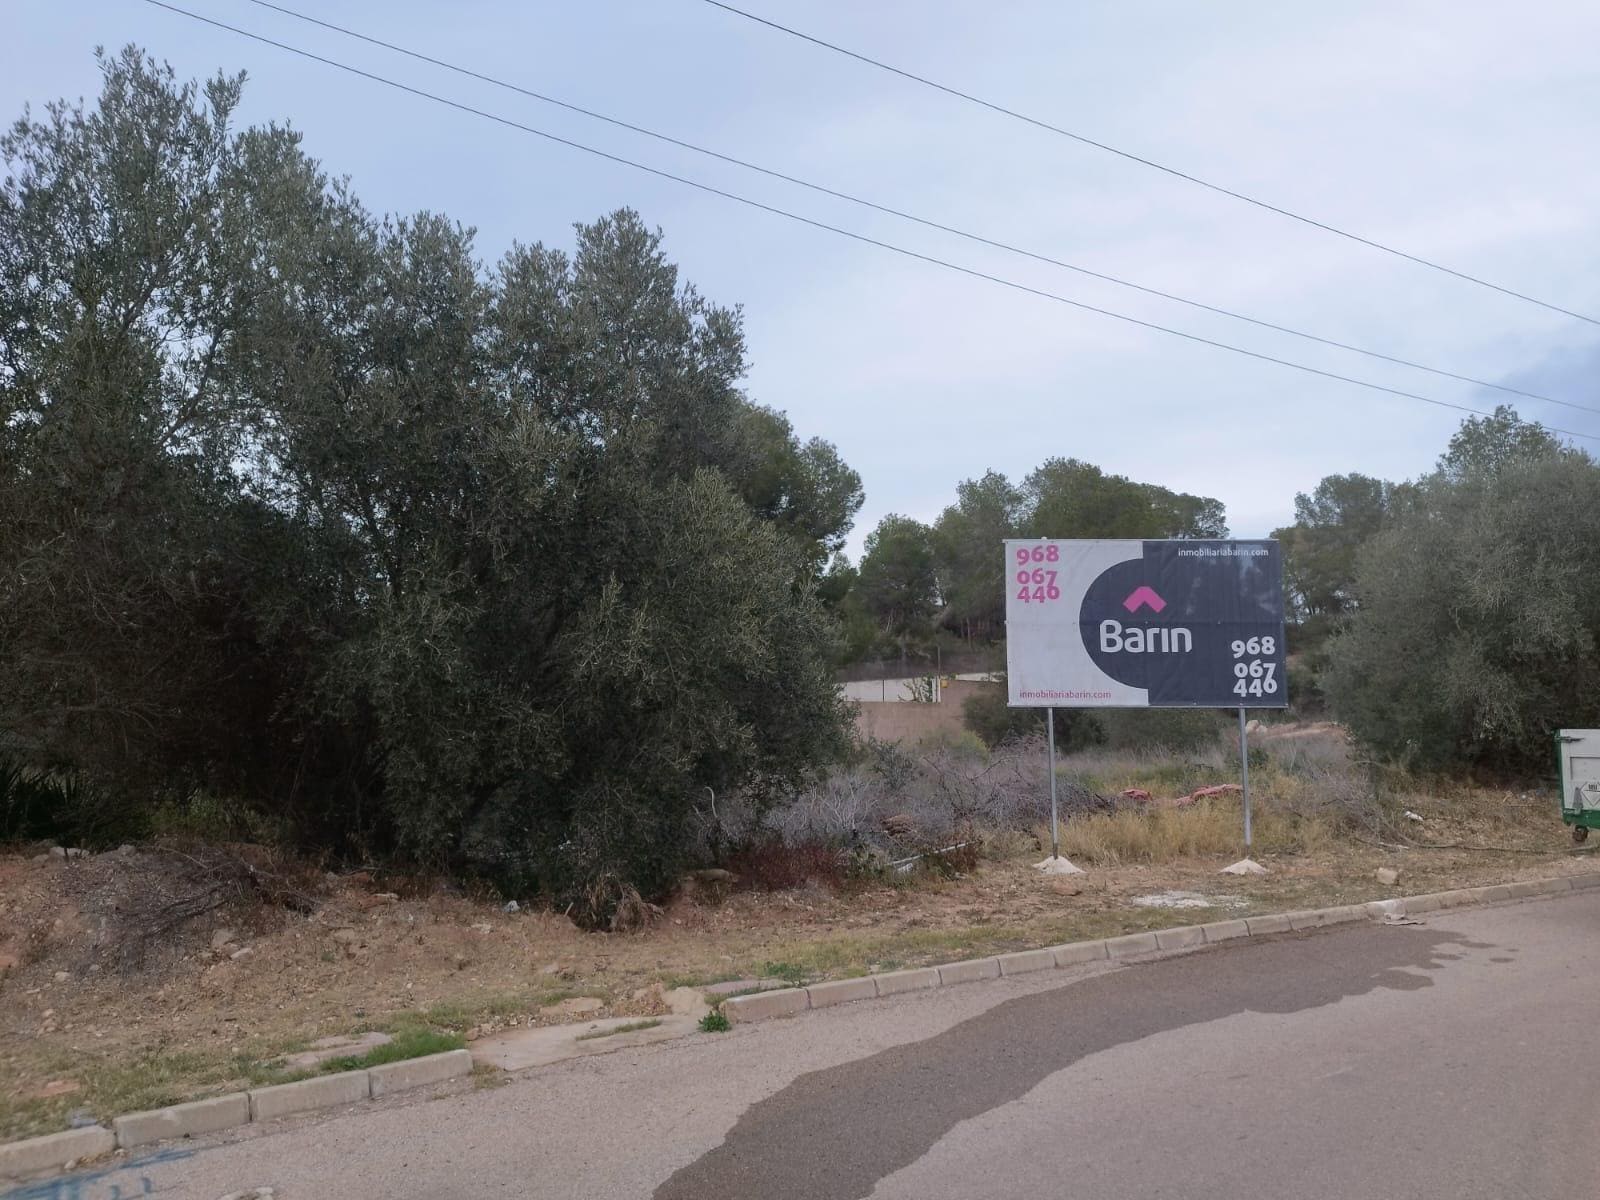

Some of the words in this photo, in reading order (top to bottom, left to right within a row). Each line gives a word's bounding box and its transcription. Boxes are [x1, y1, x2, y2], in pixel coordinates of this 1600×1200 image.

[1016, 544, 1059, 566] 968
[1177, 547, 1269, 558] inmobiliariabarin.com
[1016, 567, 1058, 588] 067
[1099, 619, 1192, 653] Barin
[1231, 635, 1276, 659] 968
[1233, 658, 1277, 680] 067
[1019, 689, 1112, 700] inmobiliariabarin.com
